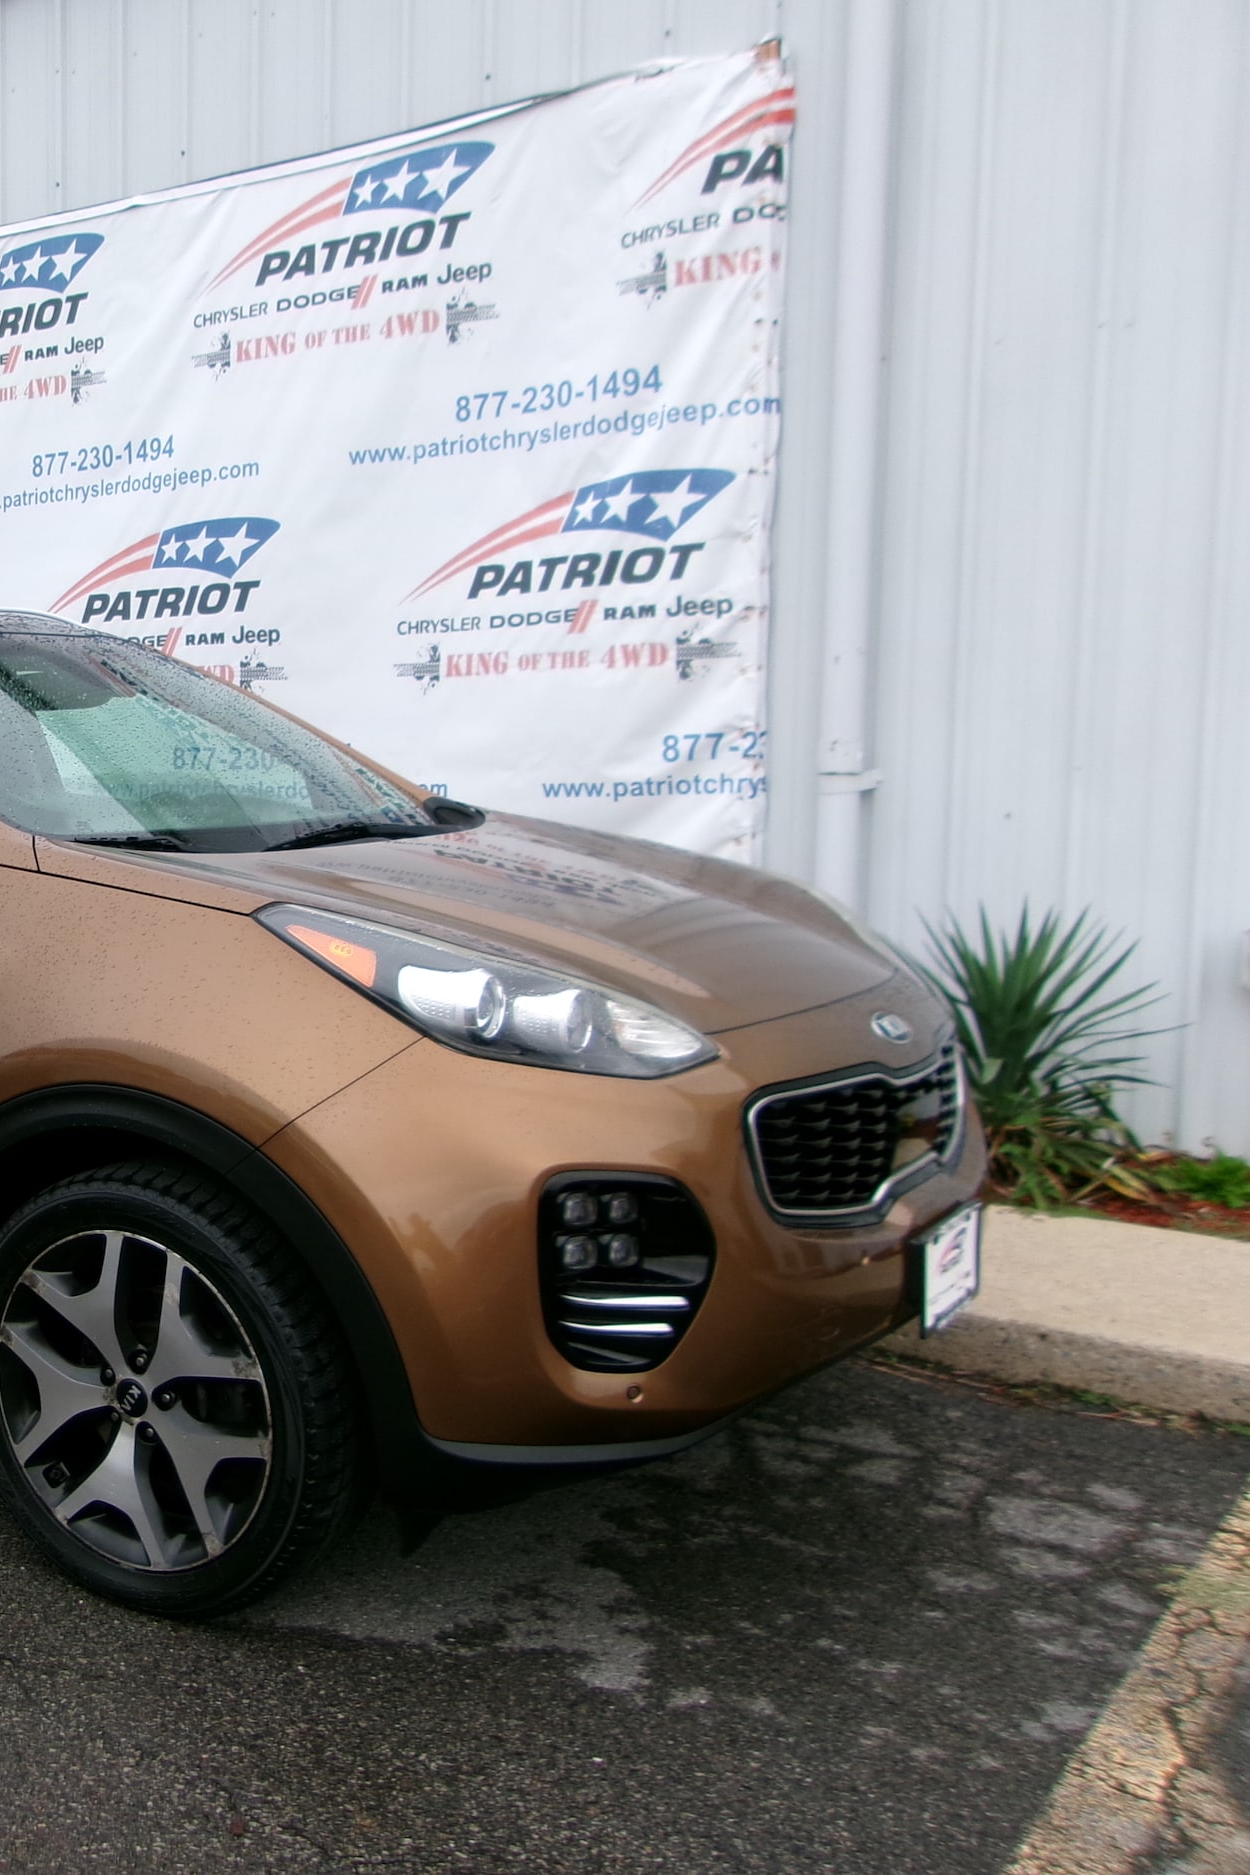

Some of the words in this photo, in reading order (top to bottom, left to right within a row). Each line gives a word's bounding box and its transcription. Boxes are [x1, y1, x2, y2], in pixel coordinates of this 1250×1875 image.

[255, 211, 472, 287] PATRIOT
[621, 213, 721, 249] CHRYSLER
[675, 246, 762, 287] KING
[193, 301, 268, 329] CHRYSLER
[276, 285, 360, 312] DODGE
[381, 274, 428, 294] RAM
[437, 262, 492, 286] Jeep
[24, 345, 58, 362] RAM
[64, 335, 104, 357] Jeep
[235, 331, 296, 363] KING
[304, 330, 326, 350] OF
[331, 323, 371, 345] THE
[379, 309, 440, 338] 4WD
[24, 375, 67, 400] 4WD
[455, 364, 663, 423] 877-230-1494
[349, 395, 782, 465] www.patriotchryslerdodgejeep.com
[32, 435, 175, 478] 877-230-1494
[467, 542, 706, 599] PATRIOT
[82, 580, 261, 624] PATRIOT
[397, 617, 481, 636] CHRYSLER
[489, 609, 579, 629] DODGE
[603, 605, 656, 621] RAM
[666, 596, 733, 620] Jeep
[185, 632, 225, 646] RAM
[232, 626, 281, 647] Jeep
[445, 652, 508, 678] KING
[518, 653, 543, 671] OF
[549, 650, 590, 669] THE
[600, 642, 669, 669] 4WD
